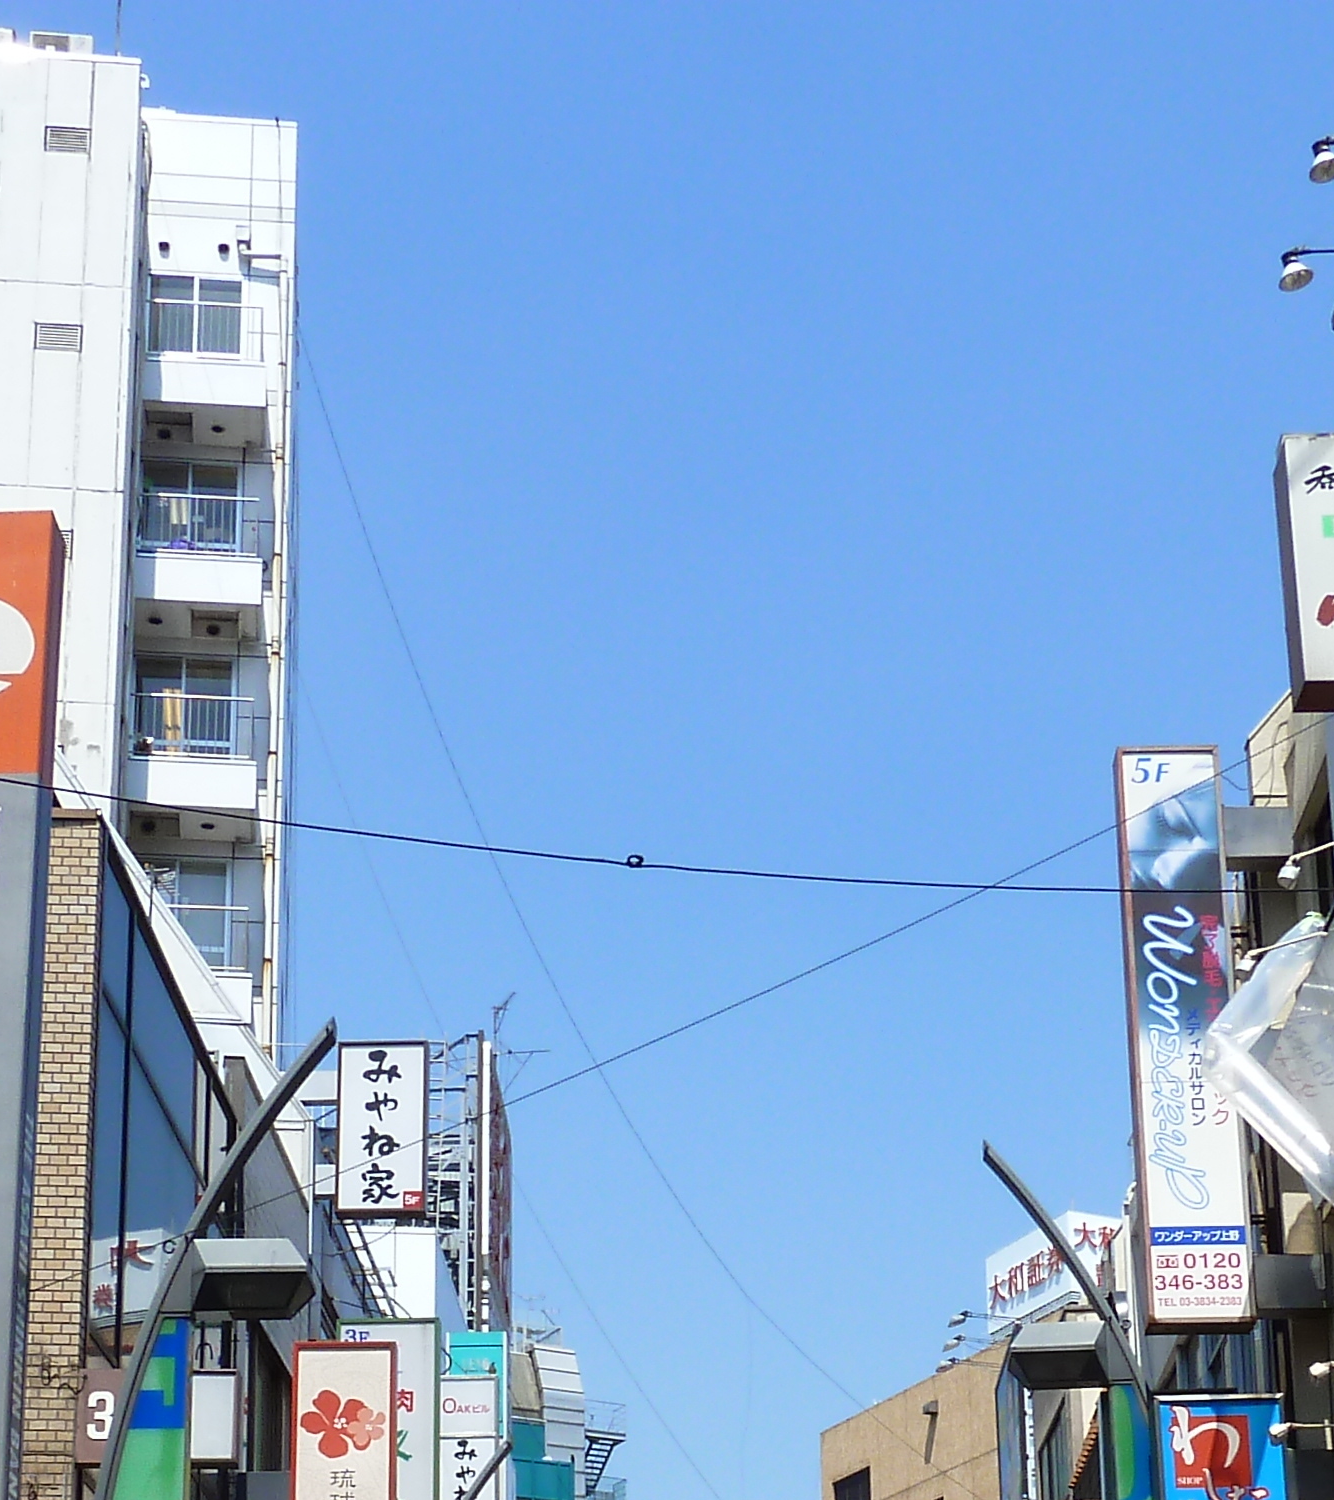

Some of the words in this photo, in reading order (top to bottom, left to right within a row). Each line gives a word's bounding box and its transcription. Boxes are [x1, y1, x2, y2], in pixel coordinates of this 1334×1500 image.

[1131, 757, 1170, 785] 5F
[1186, 1008, 1206, 1127] メディカルサロン
[362, 1050, 402, 1205] みやね家
[404, 1194, 421, 1206] 5F
[1154, 1230, 1240, 1243] ワンダーアップ上野
[1184, 1252, 1241, 1269] 0120
[1154, 1274, 1243, 1291] 346-383
[1158, 1296, 1177, 1307] TEL
[1177, 1476, 1204, 1485] SHOP
